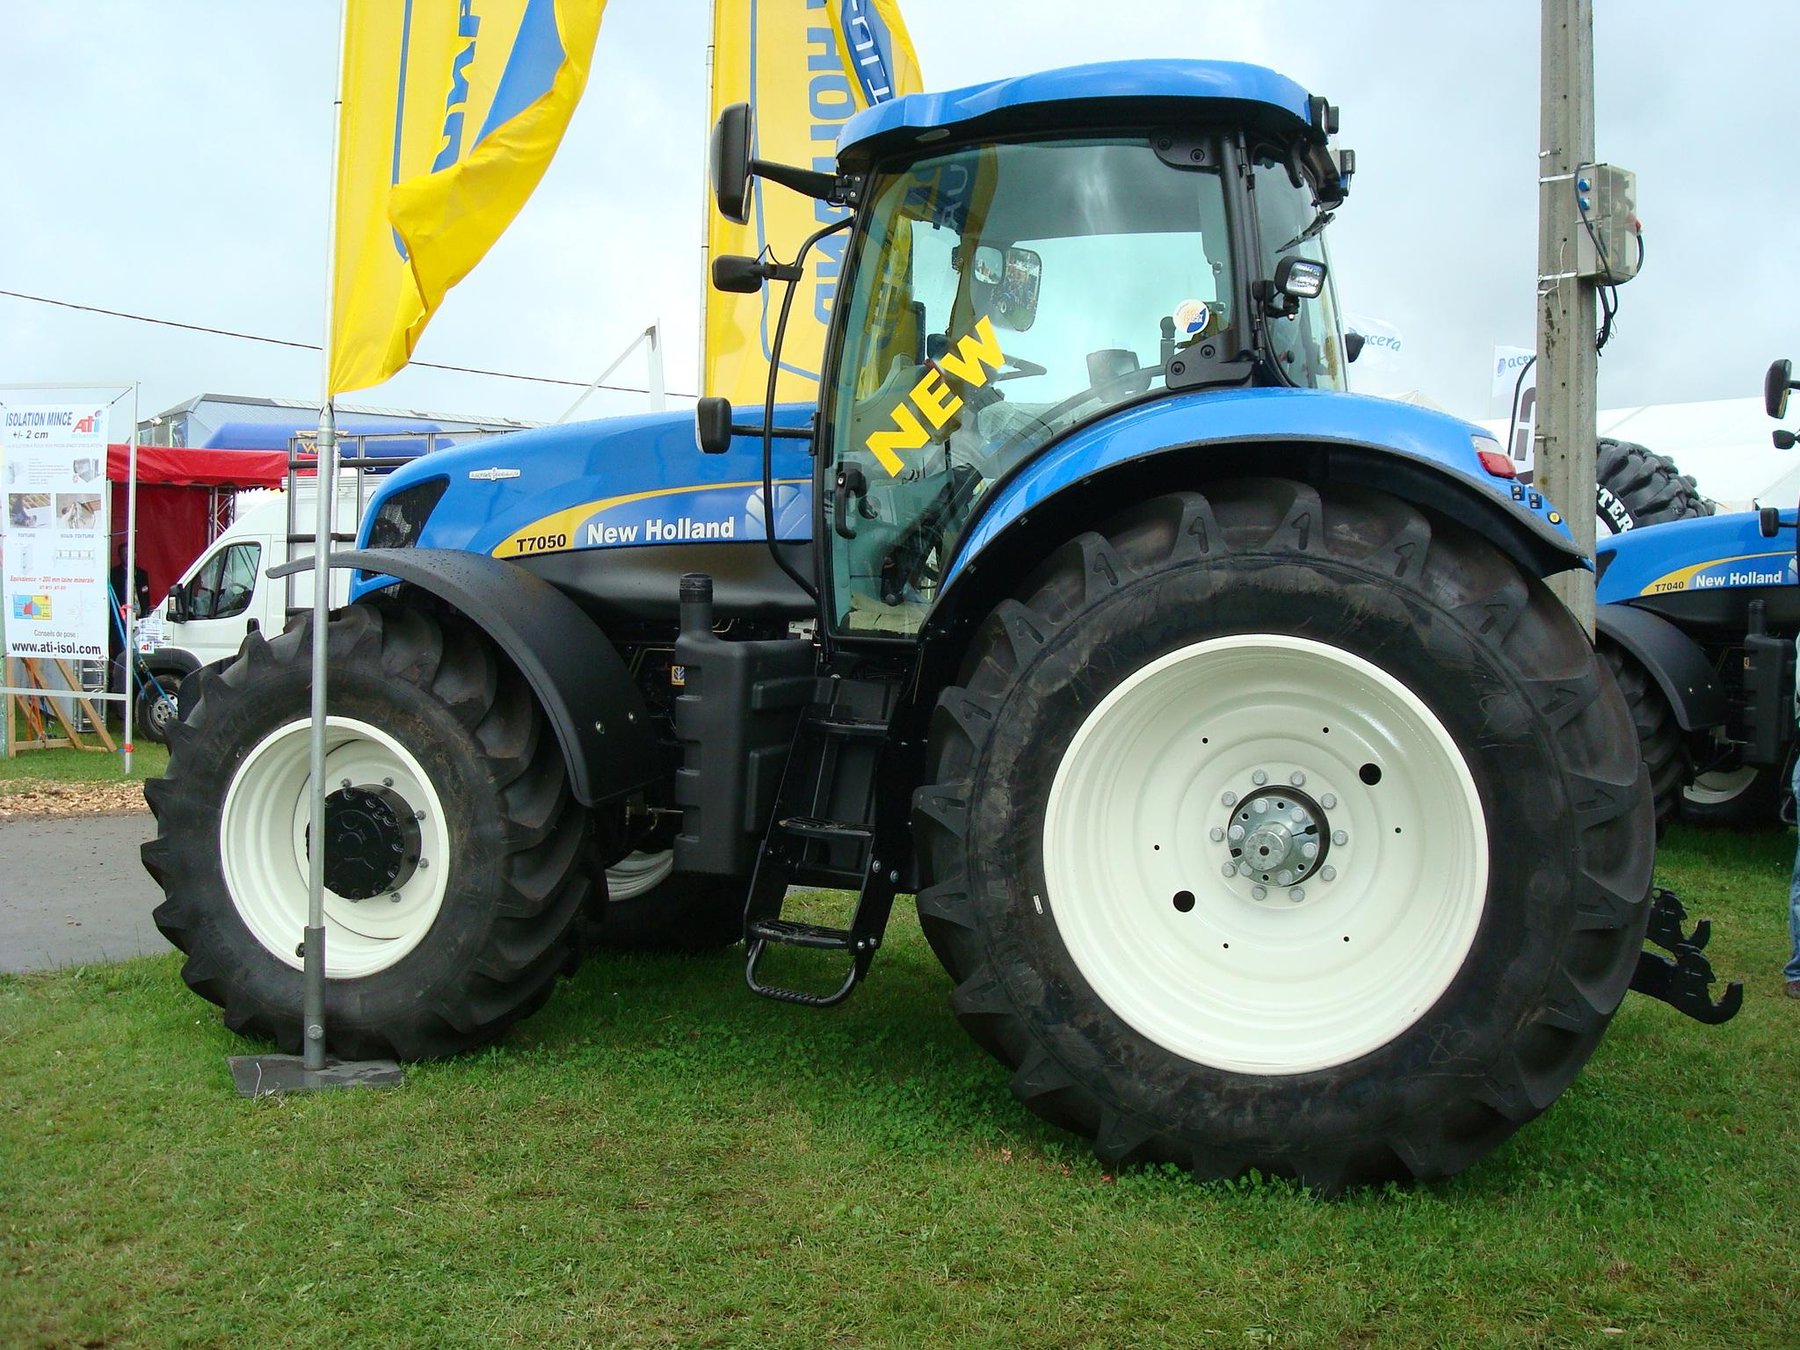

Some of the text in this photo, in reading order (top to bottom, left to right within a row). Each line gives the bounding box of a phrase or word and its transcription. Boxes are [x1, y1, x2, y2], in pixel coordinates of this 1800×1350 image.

[865, 315, 1005, 477] NEW
[5, 412, 73, 426] ISOLATION MINCE
[26, 430, 32, 439] 2
[1596, 483, 1634, 532] TER
[516, 516, 735, 551] T7050 New Holland
[1655, 571, 1782, 592] T7040 New Holland
[56, 630, 62, 638] de
[12, 641, 101, 655] www.ati-isol.com
